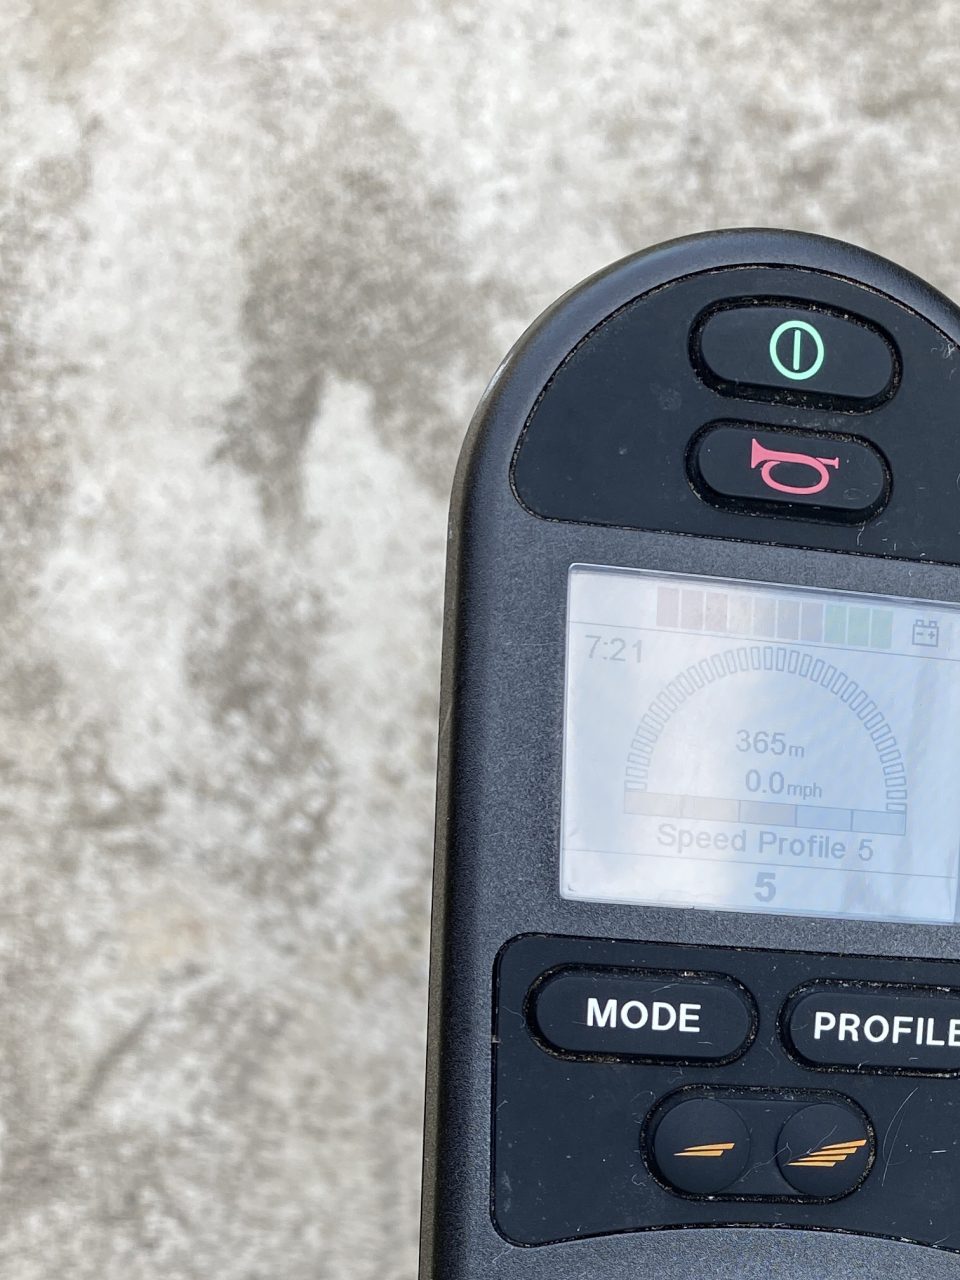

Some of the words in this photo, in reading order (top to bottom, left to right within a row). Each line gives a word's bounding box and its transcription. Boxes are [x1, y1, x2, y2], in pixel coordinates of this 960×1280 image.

[584, 634, 645, 664] 7:21
[657, 823, 747, 857] Speed
[758, 831, 847, 861] Profile
[858, 838, 875, 862] 5
[753, 872, 778, 903] 5
[586, 997, 702, 1033] MODE
